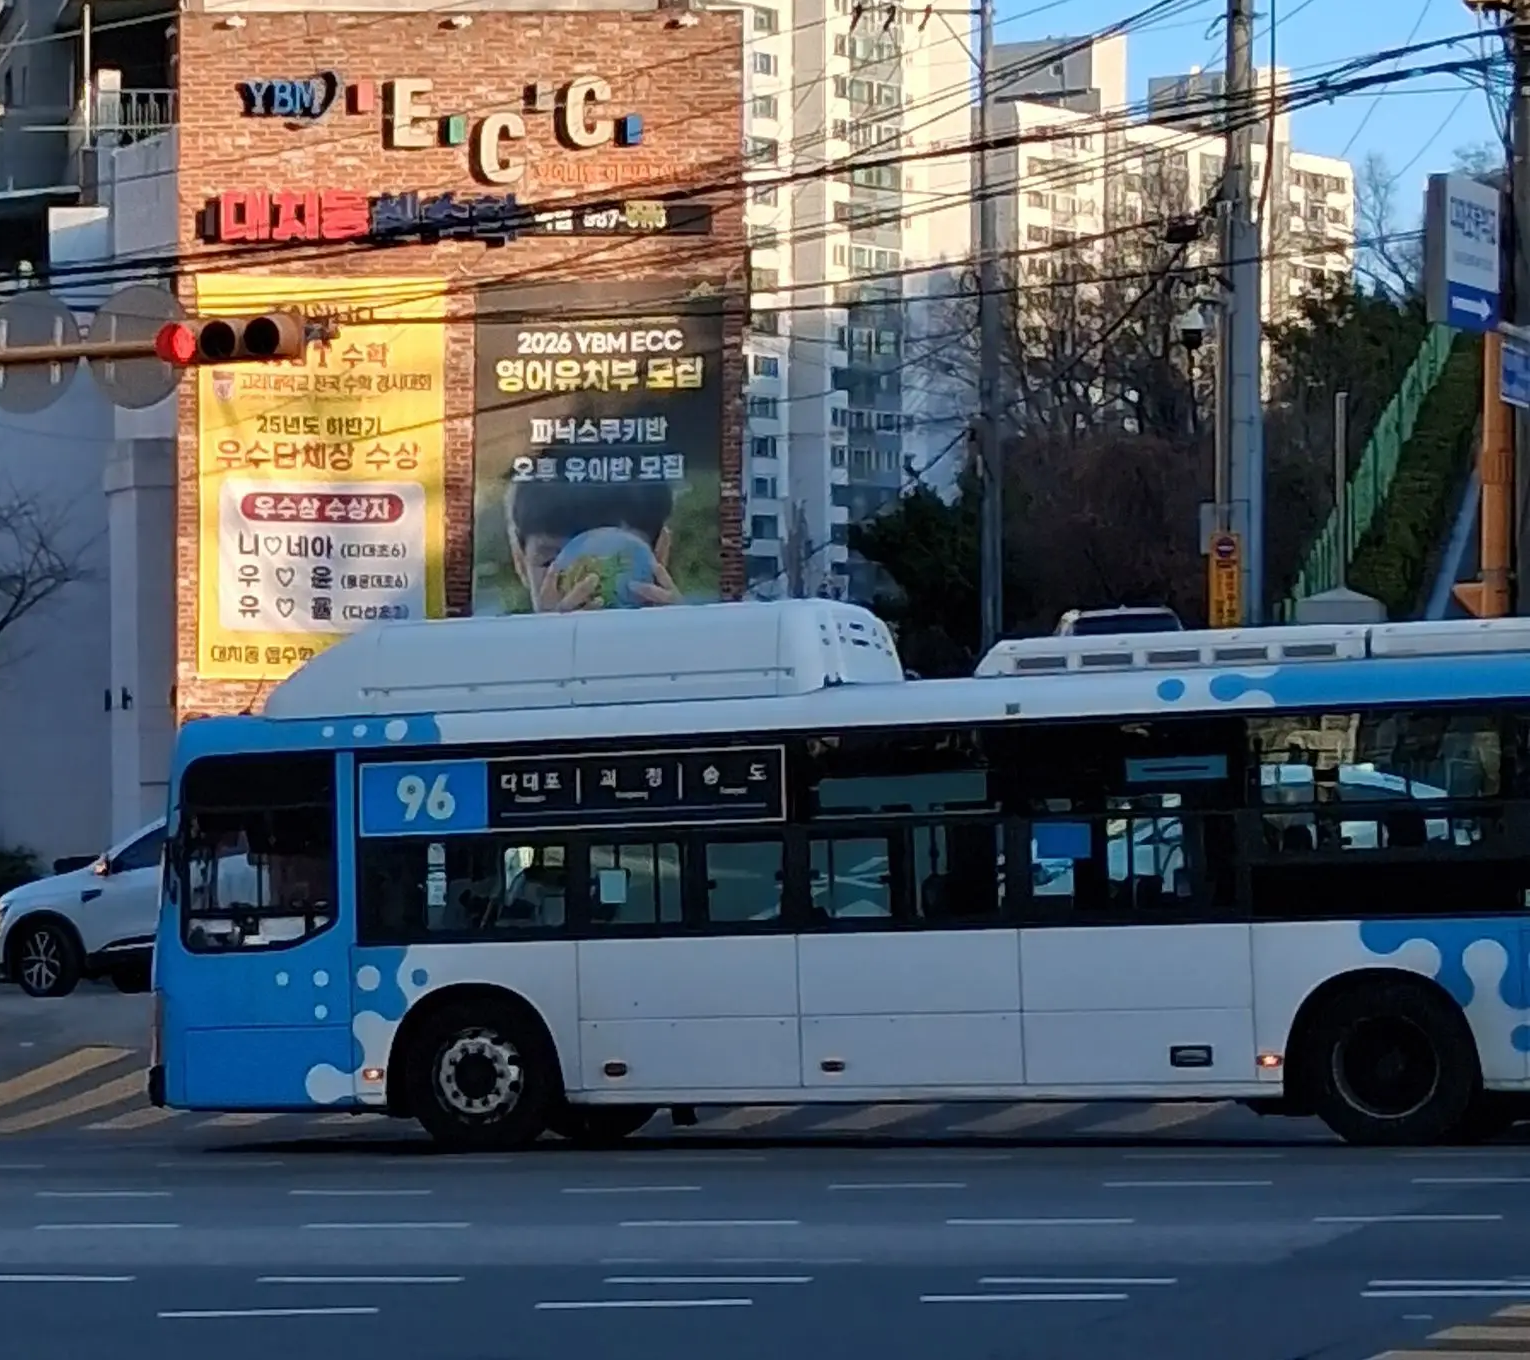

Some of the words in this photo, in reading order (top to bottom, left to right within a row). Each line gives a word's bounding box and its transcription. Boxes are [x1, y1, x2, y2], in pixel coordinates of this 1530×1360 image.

[244, 80, 325, 114] YBM
[518, 332, 572, 354] 2026
[575, 331, 627, 353] YBM
[631, 329, 684, 353] ECC
[496, 358, 640, 392] 영어유치부
[645, 356, 705, 389] 모집
[256, 414, 320, 436] 25년도
[326, 416, 383, 437] 하반기
[216, 439, 354, 471] 우수단체상
[365, 441, 420, 471] 수상
[638, 453, 686, 480] 모집
[325, 496, 390, 520] 수상자
[397, 773, 456, 821] 96
[500, 772, 562, 793] 다대포
